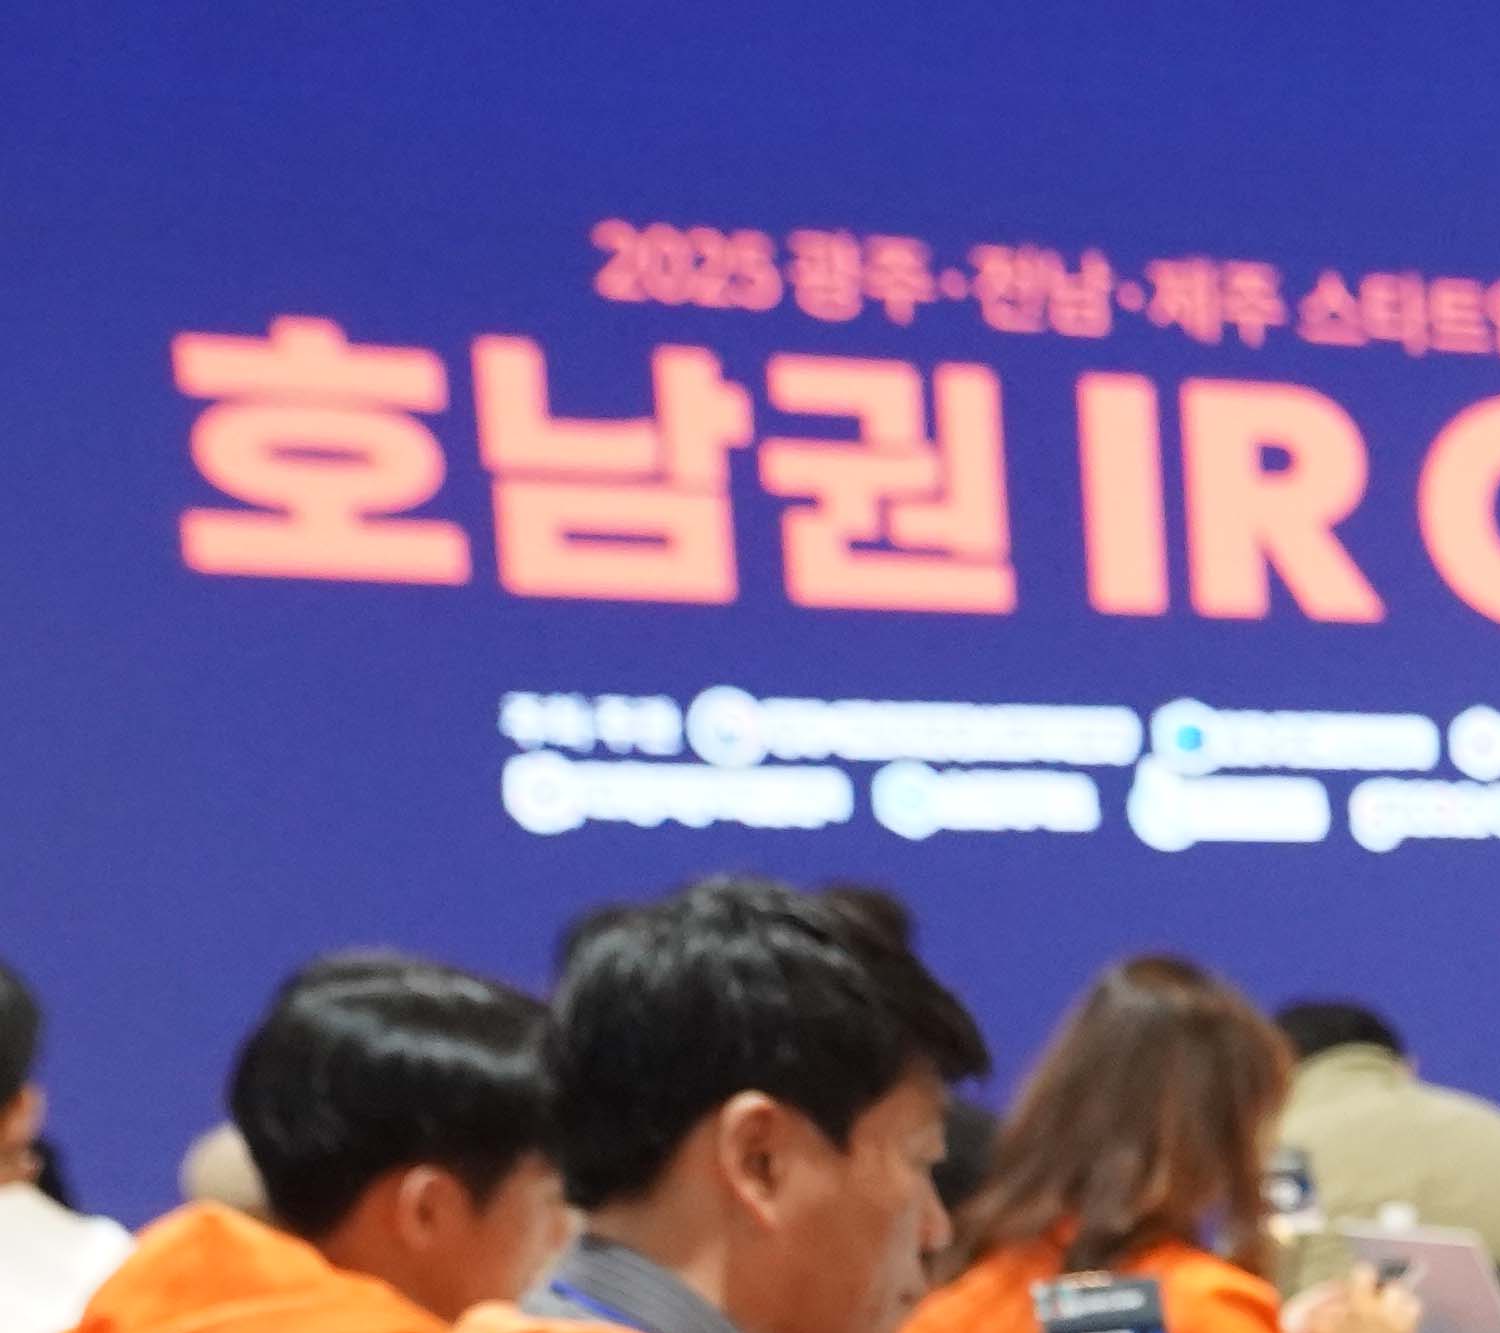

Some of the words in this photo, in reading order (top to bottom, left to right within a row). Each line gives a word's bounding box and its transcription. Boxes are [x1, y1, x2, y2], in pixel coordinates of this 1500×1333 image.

[592, 219, 783, 311] 2025
[171, 314, 1018, 616] 호남권
[1075, 370, 1387, 622] IR
